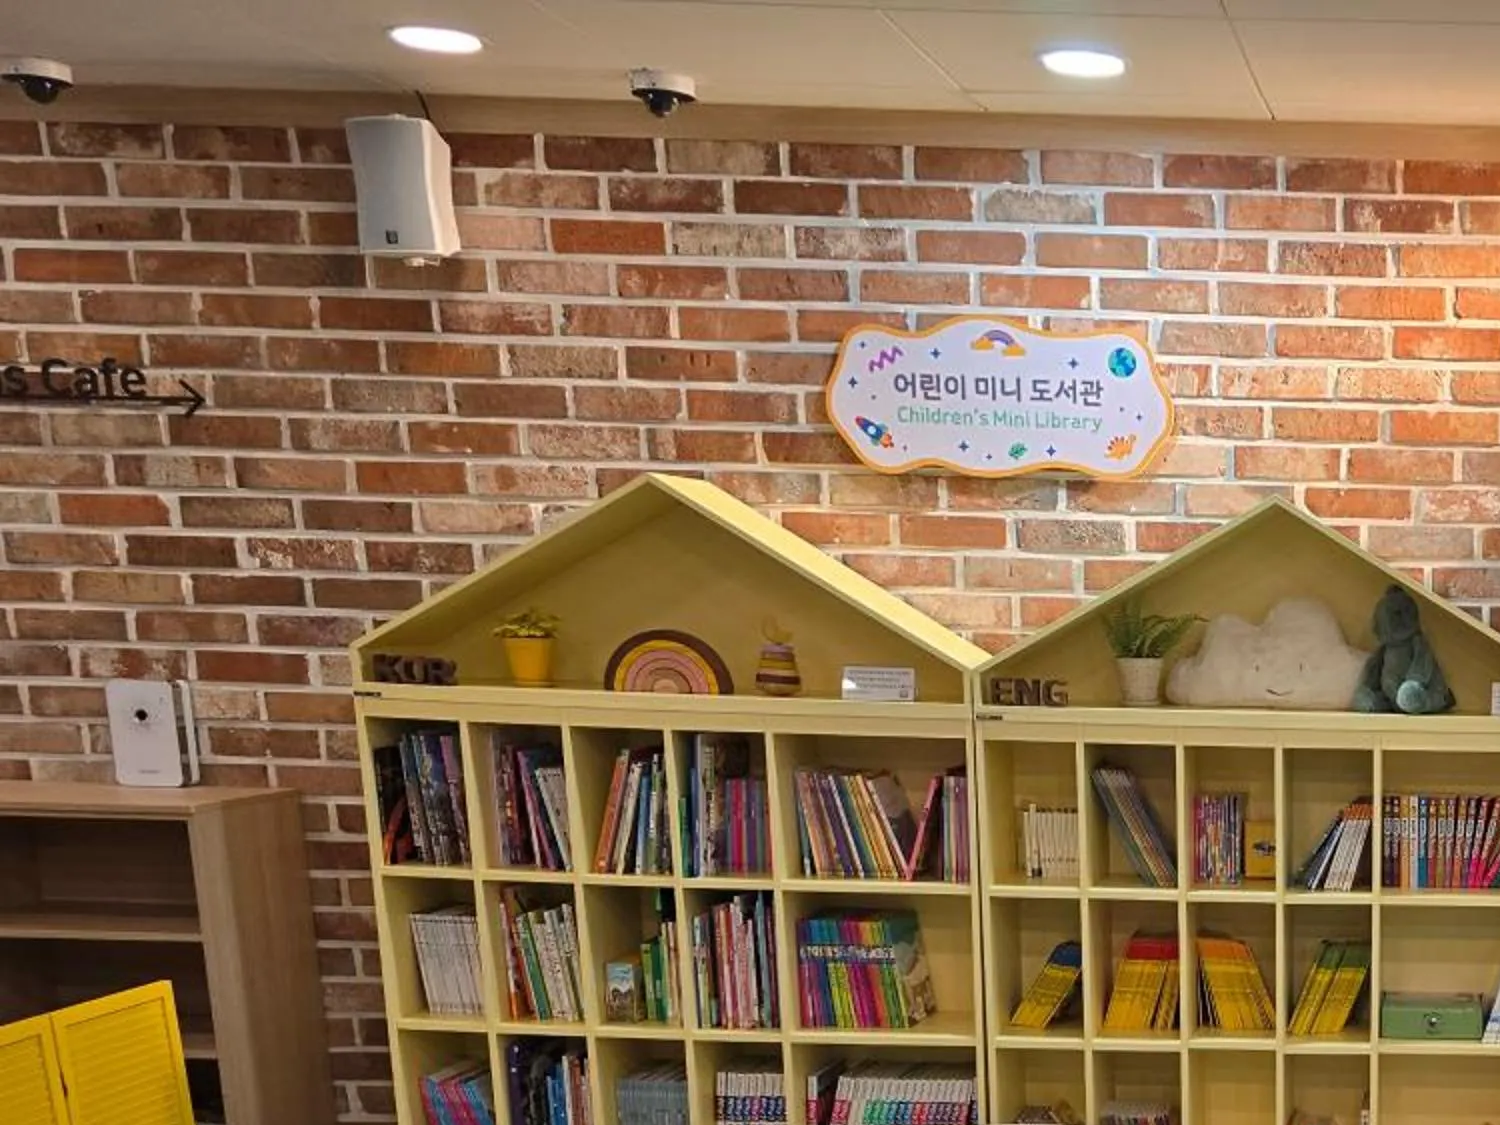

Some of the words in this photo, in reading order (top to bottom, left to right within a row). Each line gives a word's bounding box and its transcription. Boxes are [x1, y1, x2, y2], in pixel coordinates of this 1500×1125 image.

[42, 357, 146, 400] Cafe
[893, 372, 967, 401] 어린이
[974, 375, 1022, 403] 미니
[1029, 377, 1104, 407] 도서관
[897, 405, 990, 427] Children's
[994, 410, 1031, 429] Mini
[1034, 412, 1103, 434] Library
[990, 677, 1068, 708] ENG
